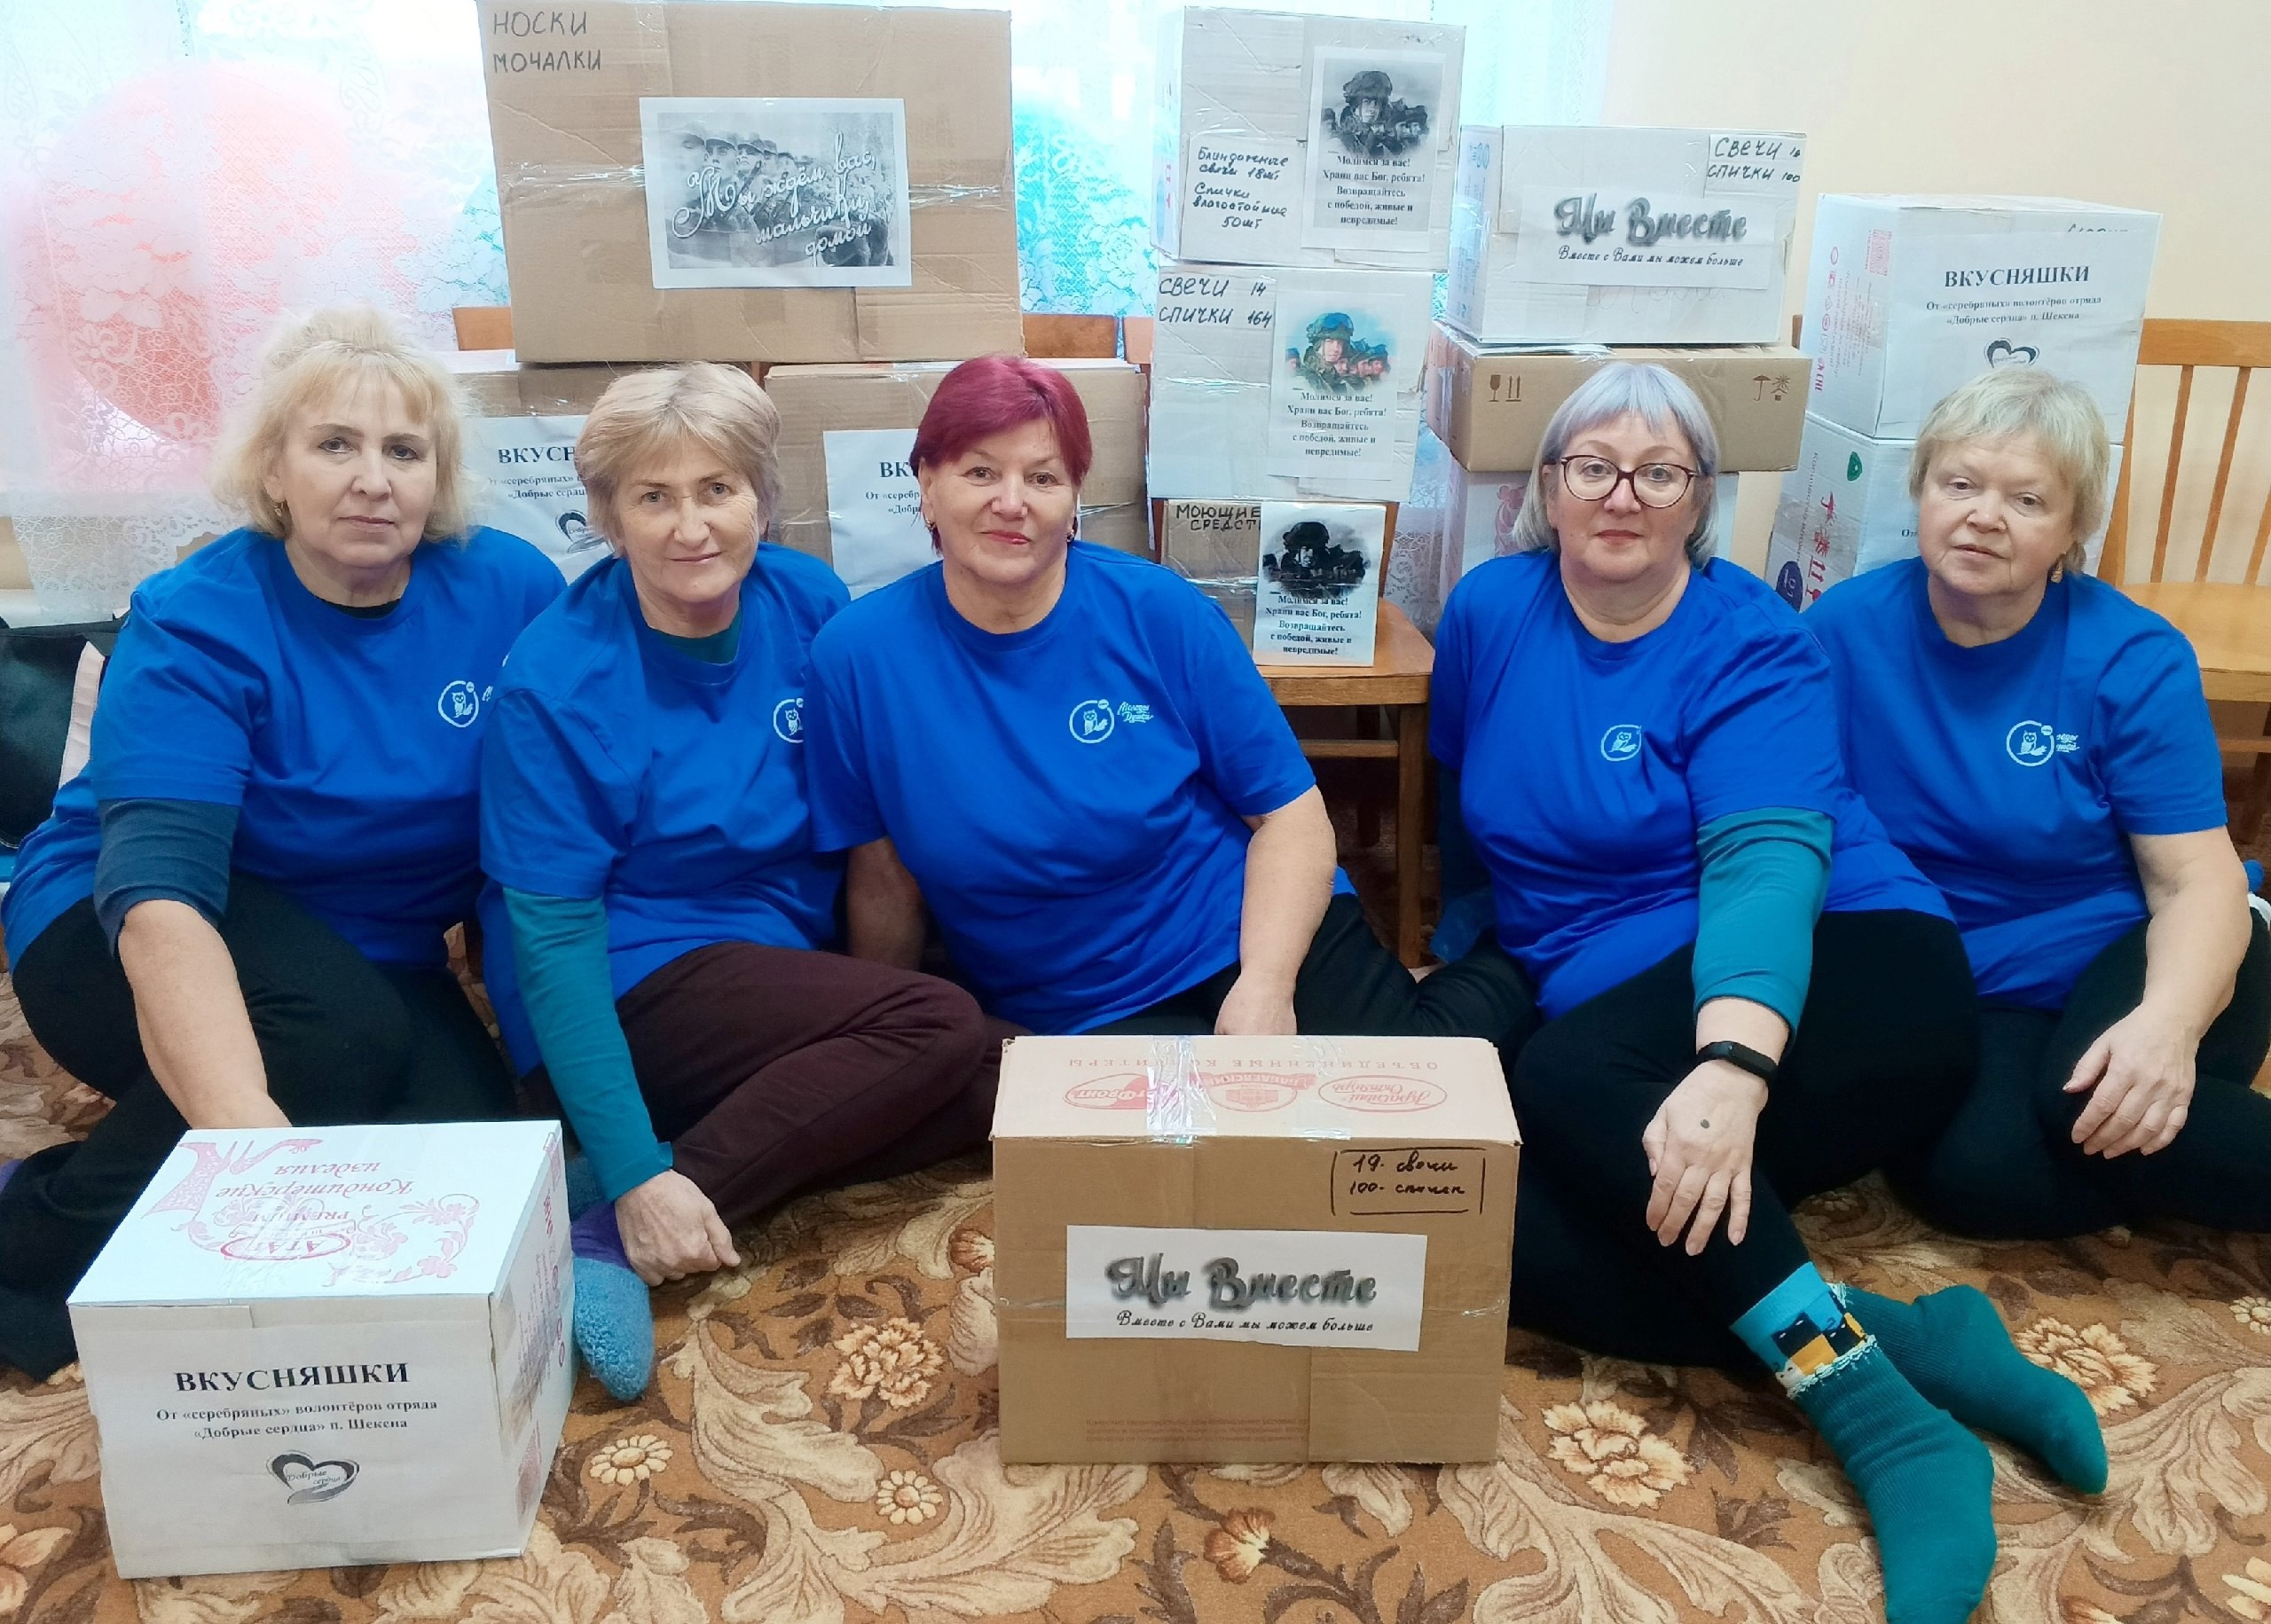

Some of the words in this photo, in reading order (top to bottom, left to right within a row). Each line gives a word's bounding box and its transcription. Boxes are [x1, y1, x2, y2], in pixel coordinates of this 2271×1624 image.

[493, 11, 586, 36] НОСКИ
[493, 50, 601, 73] МОЧАЛКИ
[1337, 155, 1379, 166] Молимся
[1392, 158, 1411, 168] вас!
[1323, 169, 1351, 181] Храни
[1391, 173, 1425, 184] ребята!
[1781, 171, 1801, 182] 100
[672, 166, 756, 239] Мы
[761, 166, 826, 218] ждём
[834, 131, 876, 174] вас,
[1194, 182, 1250, 199] Спички
[1337, 185, 1405, 197] Возвращайтесь
[1334, 200, 1372, 211] победой,
[1222, 216, 1262, 230] 50шт
[1340, 216, 1398, 226] невредимые!
[1553, 192, 1616, 244] Мы
[1624, 197, 1747, 247] Вместе
[1559, 245, 1600, 261] Вместе
[1613, 247, 1644, 263] Вами
[1666, 255, 1702, 264] можем
[1706, 253, 1743, 266] больше
[1945, 266, 2090, 287] ВКУСНЯШКИ
[1250, 282, 1267, 296] 14
[1926, 302, 1939, 310] От
[1942, 300, 2010, 311] «серебряных»
[2013, 297, 2067, 308] волонтёров
[2070, 296, 2102, 305] отряда
[1247, 310, 1273, 328] 164
[1946, 315, 1989, 326] «Добрые
[1991, 315, 2027, 325] сердца»
[2041, 311, 2079, 320] Шексна
[1301, 392, 1341, 402] Молимся
[1355, 394, 1373, 403] вас!
[1287, 404, 1316, 416] Храни
[1354, 407, 1387, 418] ребята!
[1301, 420, 1369, 431] Возвращайтесь
[1299, 433, 1336, 443] победой,
[1305, 448, 1362, 458] невредимые!
[500, 475, 574, 487] «серебряных»
[508, 490, 554, 500] «Добрые
[556, 489, 587, 499] сердц
[1176, 504, 1261, 520] МОЮЩИЕ
[1191, 519, 1261, 532] СРЕДСТ
[1277, 595, 1318, 604] Молимся
[1331, 597, 1348, 606] вас!
[1312, 608, 1329, 619] Бог,
[1331, 610, 1362, 620] ребята!
[1278, 620, 1346, 632] Возвращайтесь
[1277, 632, 1314, 643] победой,
[1283, 646, 1339, 655] невредимые!
[1332, 1079, 1403, 1094] Октябрь
[1348, 1091, 1430, 1106] Красный
[273, 1162, 381, 1178] изделия
[216, 1180, 413, 1199] Кондитерские
[1104, 1252, 1191, 1308] Мы
[1201, 1257, 1377, 1312] Вместе
[1117, 1310, 1175, 1327] Вместе
[1179, 1319, 1186, 1328] с
[1191, 1312, 1234, 1329] Вами
[1238, 1320, 1261, 1330] мы
[1266, 1320, 1317, 1330] можем
[1322, 1316, 1374, 1331] больше
[173, 1362, 412, 1392] ВКУСНЯШКИ
[156, 1409, 178, 1421] От
[182, 1407, 290, 1424] «серебряных»
[295, 1401, 382, 1416] волонтёров
[386, 1400, 438, 1412] отряда
[193, 1426, 261, 1440] «Добрые
[265, 1424, 326, 1436] сердца»
[348, 1418, 408, 1430] Шексна
[287, 1470, 327, 1482] Добрые
